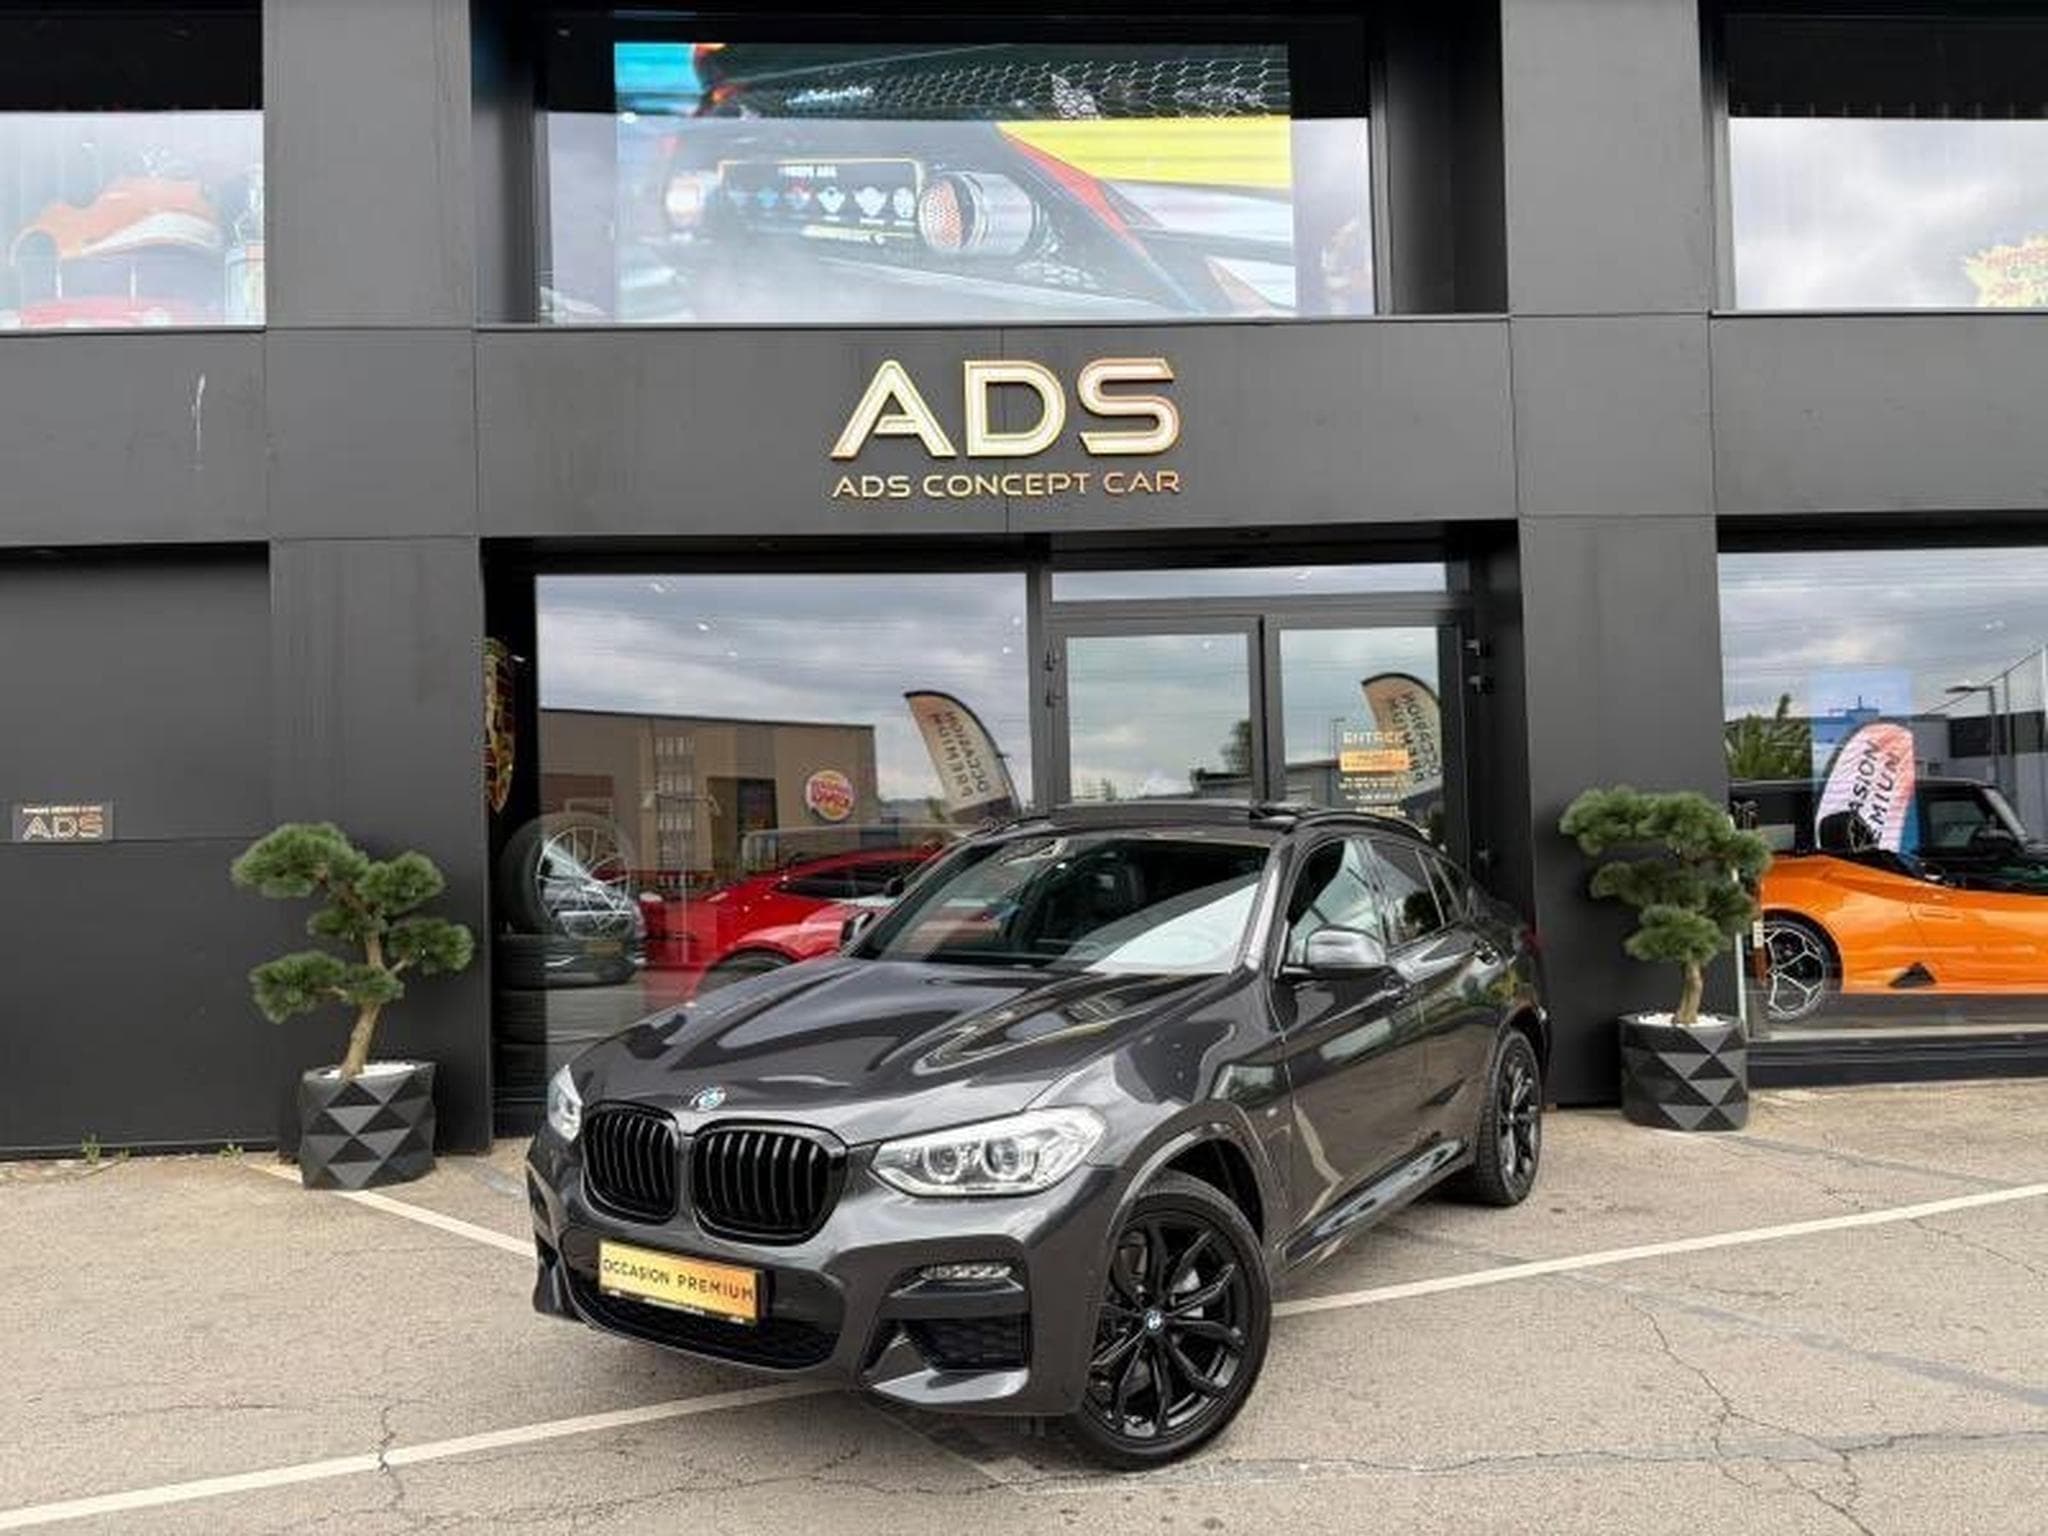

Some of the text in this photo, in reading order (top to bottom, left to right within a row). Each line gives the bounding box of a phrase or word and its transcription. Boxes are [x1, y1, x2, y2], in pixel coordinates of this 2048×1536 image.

[829, 358, 1181, 459] ADS
[832, 470, 1181, 499] ADS CONCEPT CAR
[22, 815, 104, 840] ADS
[603, 1258, 754, 1301] OCCASION PREMIUM
